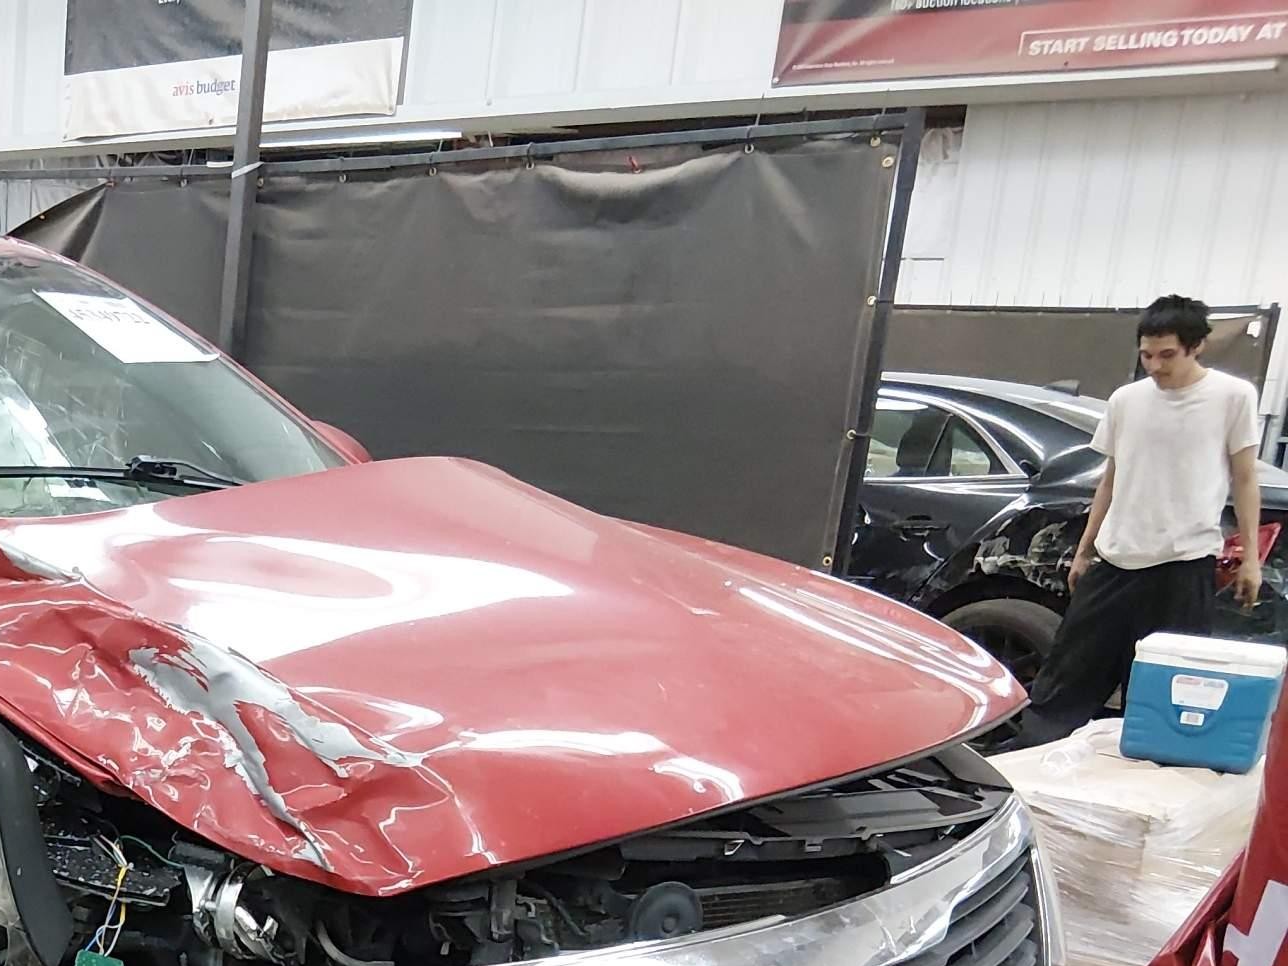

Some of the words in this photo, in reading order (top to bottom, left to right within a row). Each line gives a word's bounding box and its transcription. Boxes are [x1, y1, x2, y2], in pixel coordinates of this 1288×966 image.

[1028, 36, 1090, 57] START
[1093, 30, 1178, 52] SELLING
[1179, 23, 1256, 46] TODAY
[1256, 22, 1287, 41] AT
[172, 81, 194, 97] avis
[196, 79, 236, 96] budget
